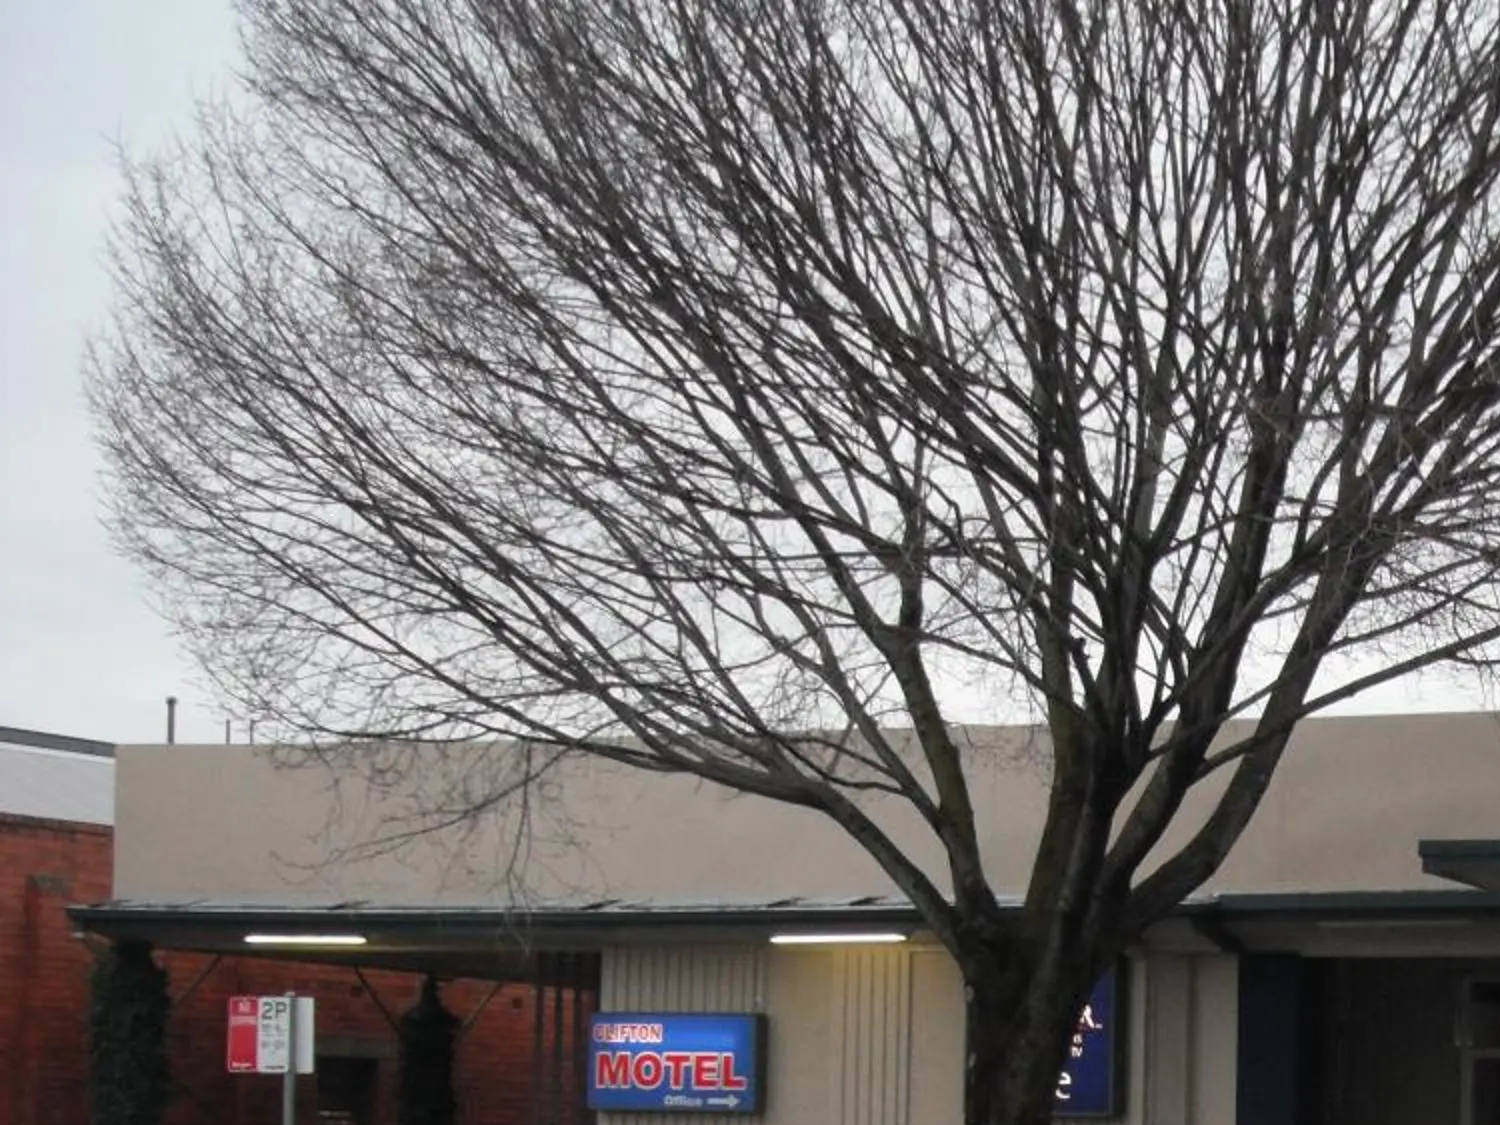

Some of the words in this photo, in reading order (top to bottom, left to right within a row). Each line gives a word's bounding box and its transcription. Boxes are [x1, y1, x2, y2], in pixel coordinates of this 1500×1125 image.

[262, 1002, 287, 1020] 2P
[593, 1023, 663, 1042] CLIFTON
[595, 1051, 747, 1088] MOTEL
